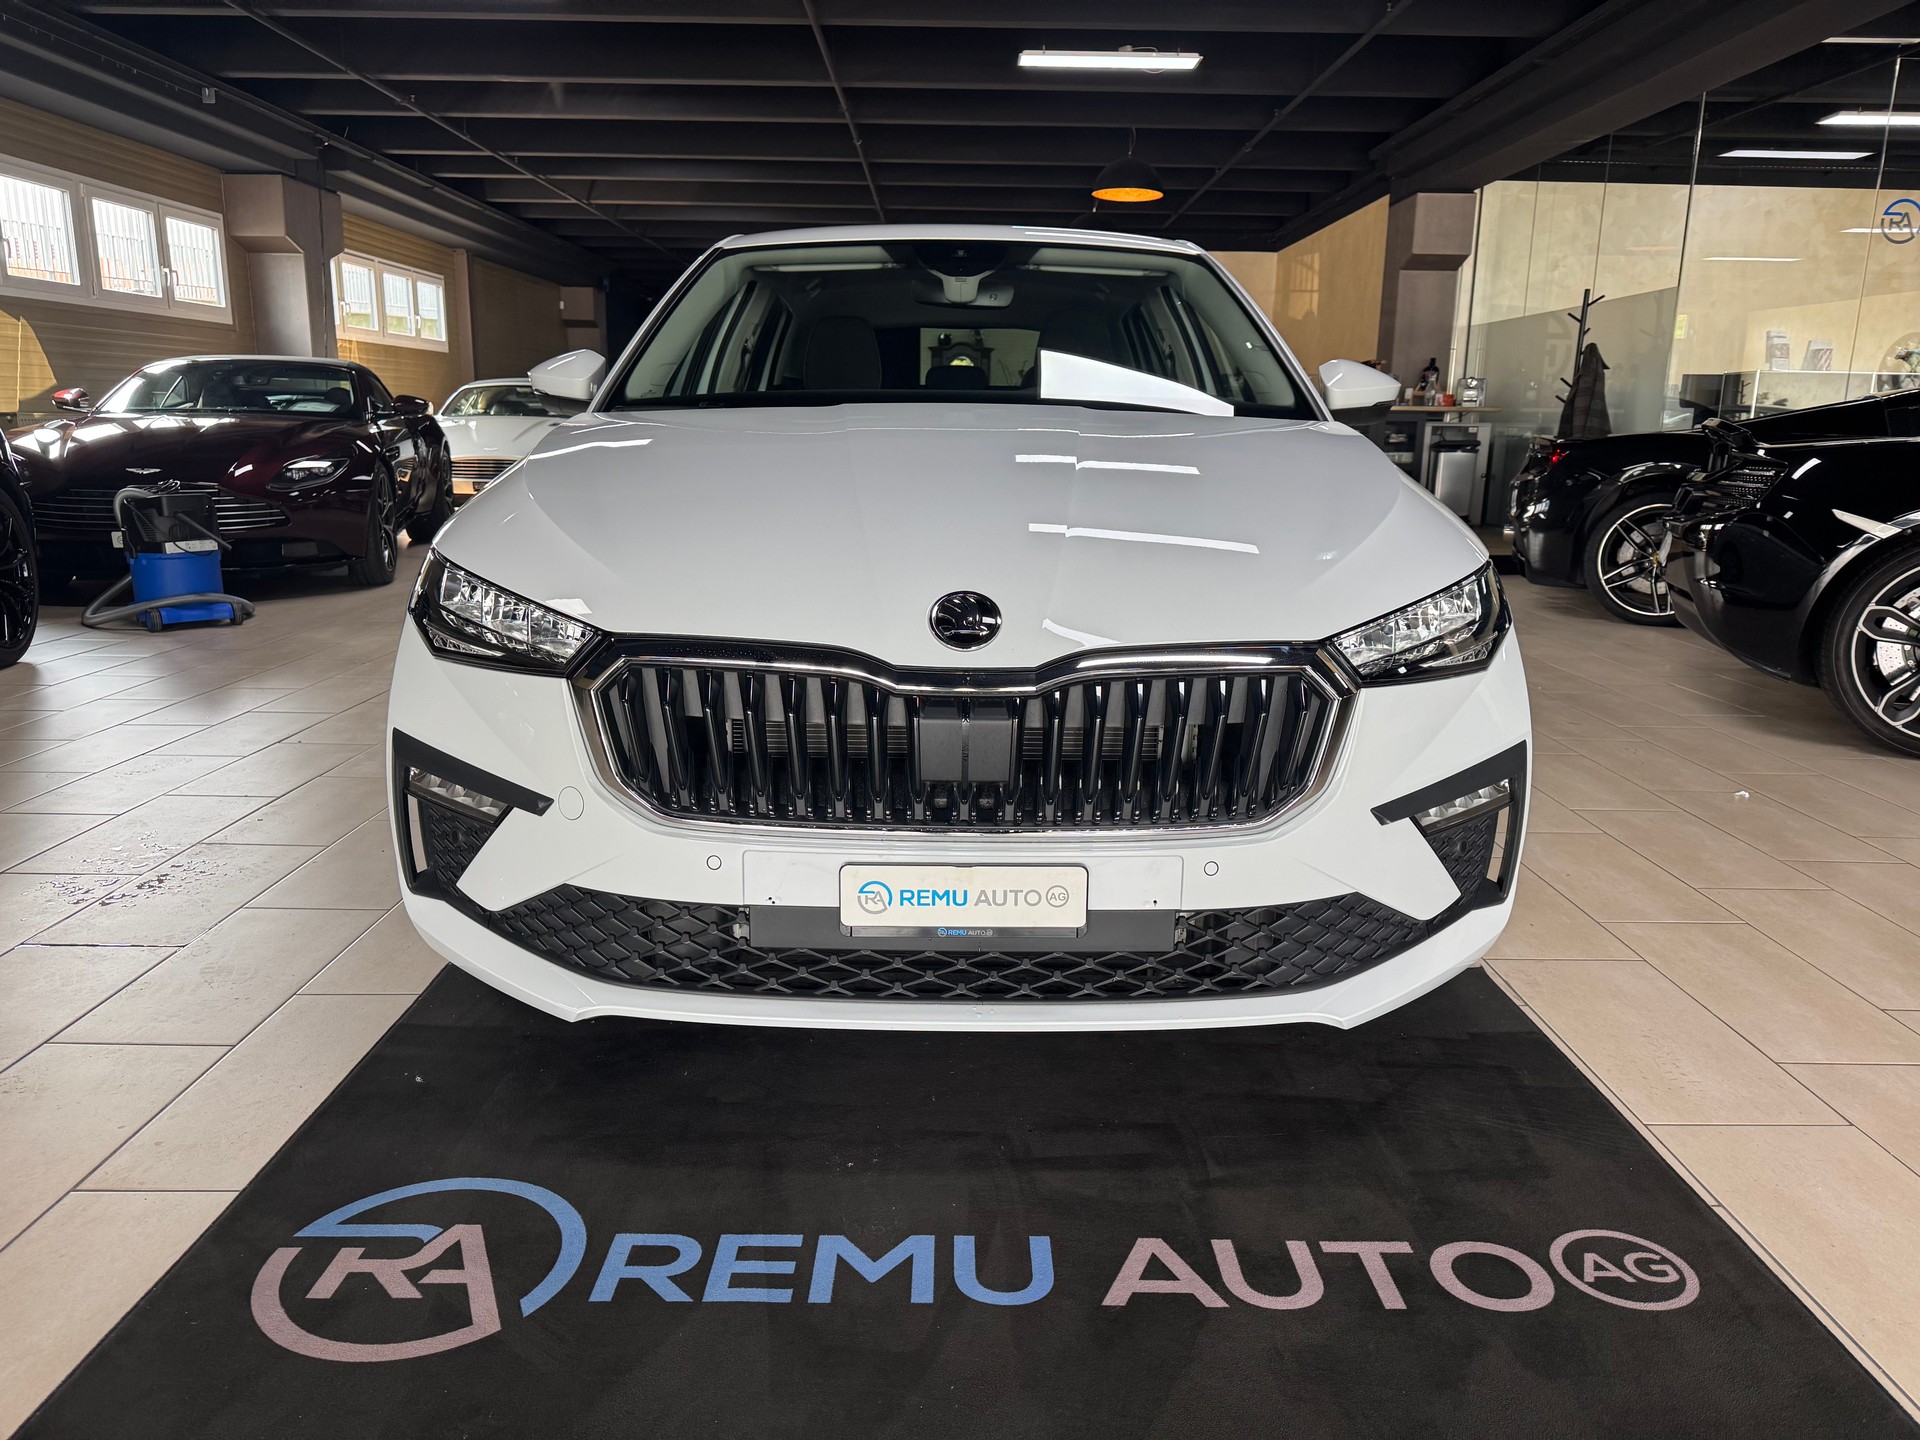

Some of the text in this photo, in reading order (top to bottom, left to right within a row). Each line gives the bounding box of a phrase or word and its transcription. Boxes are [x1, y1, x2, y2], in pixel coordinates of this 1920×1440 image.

[900, 889, 968, 907] REMU
[974, 889, 1042, 907] AUTO
[589, 1233, 1054, 1305] REMU
[1101, 1237, 1555, 1312] AUTO
